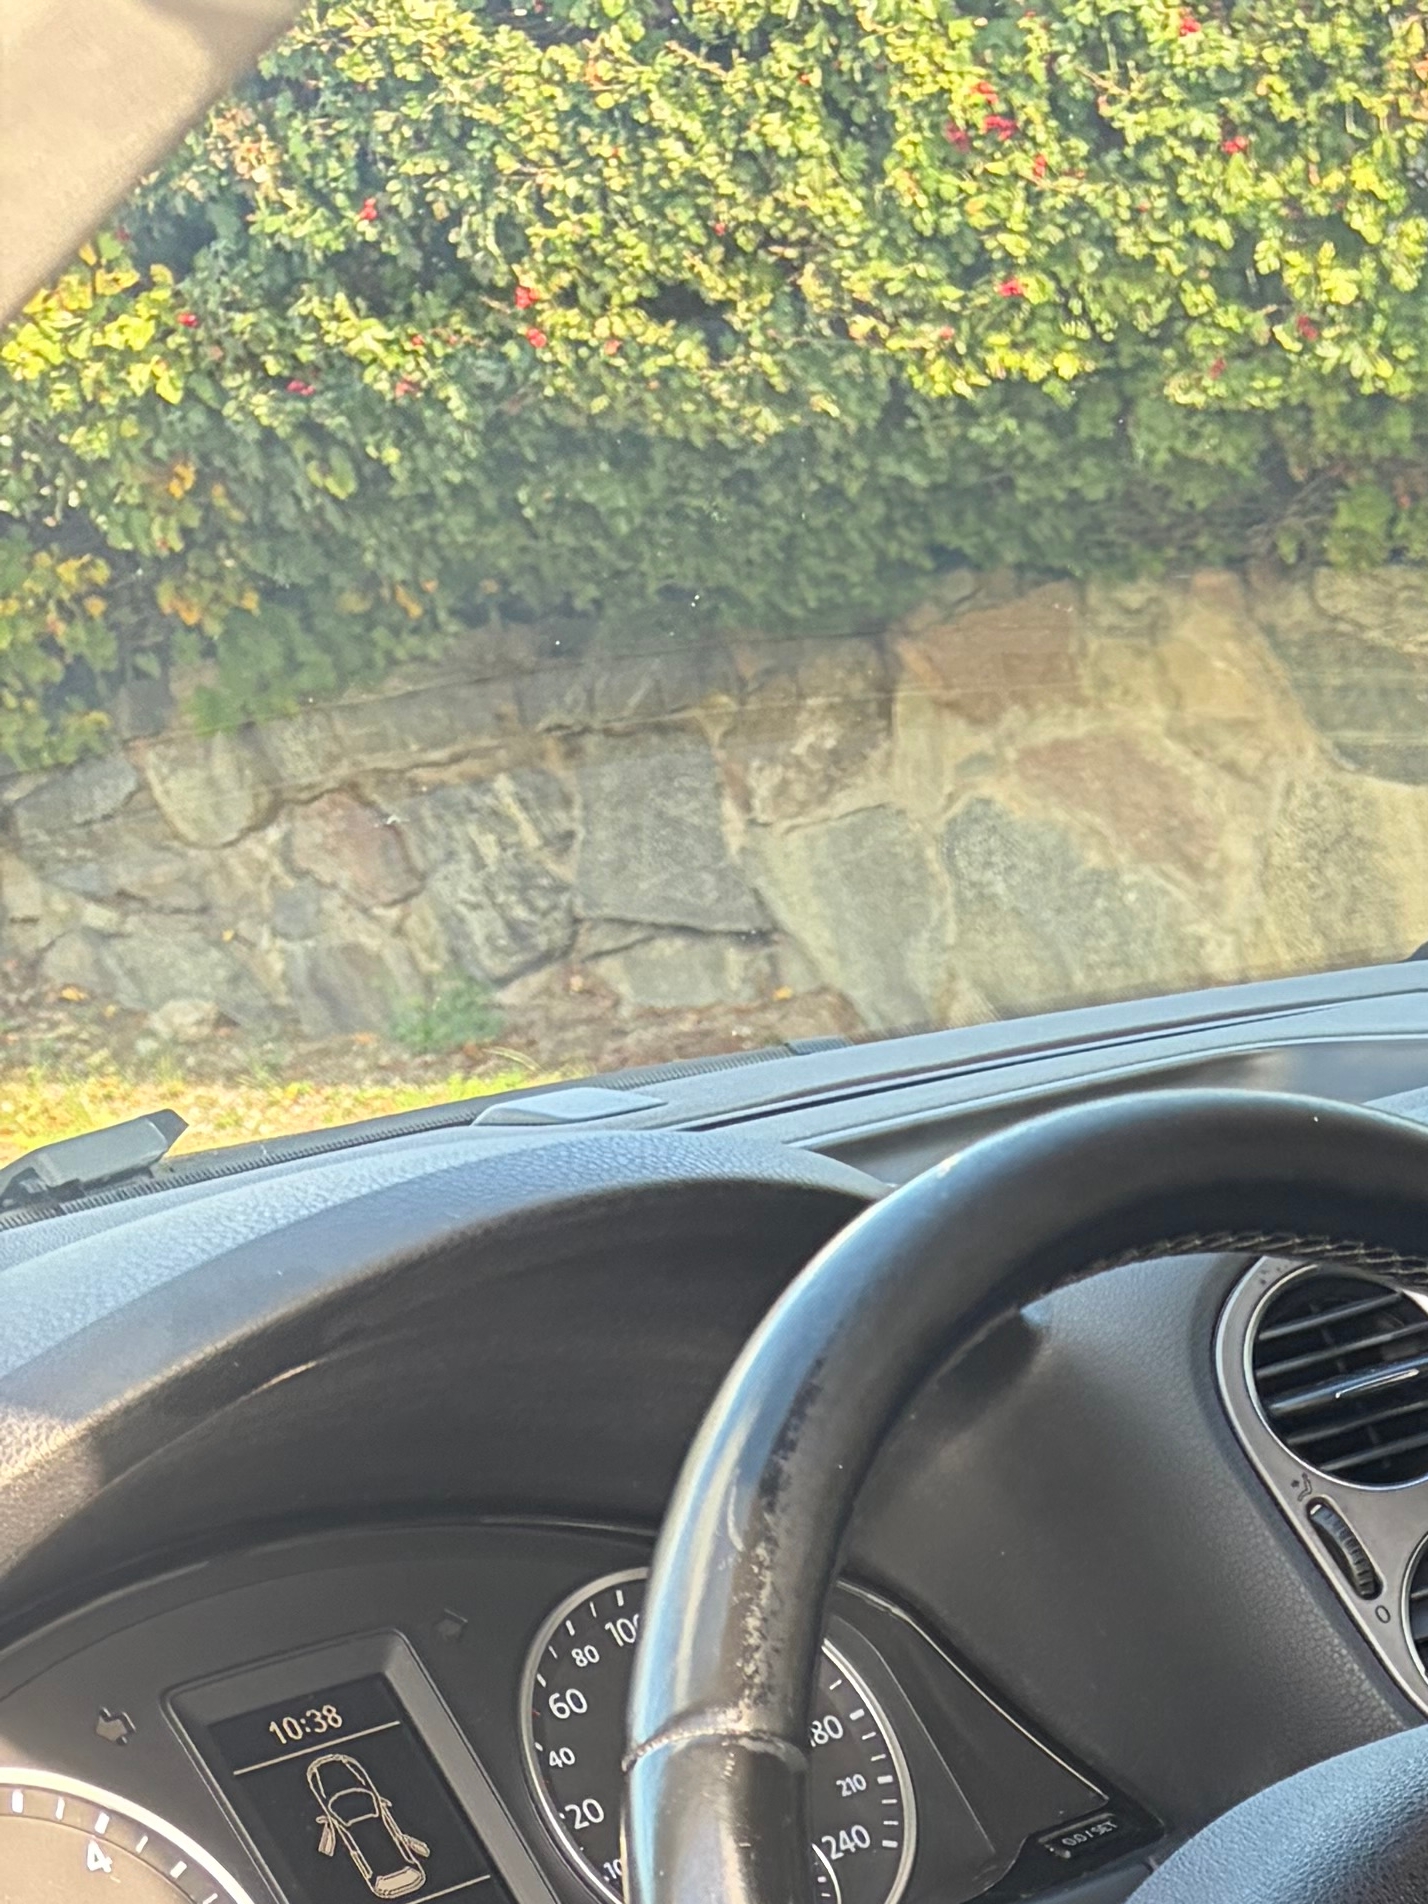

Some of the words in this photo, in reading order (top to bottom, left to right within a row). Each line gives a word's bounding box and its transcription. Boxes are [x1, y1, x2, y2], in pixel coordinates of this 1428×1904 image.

[604, 1613, 639, 1647] 10
[571, 1644, 600, 1667] 80
[548, 1688, 588, 1719] 60
[269, 1704, 343, 1744] 10:38
[810, 1715, 844, 1747] 80
[548, 1747, 576, 1768] 40
[836, 1773, 867, 1797] 210
[565, 1798, 604, 1830] 20
[86, 1839, 112, 1873] 4
[821, 1824, 871, 1861] 240
